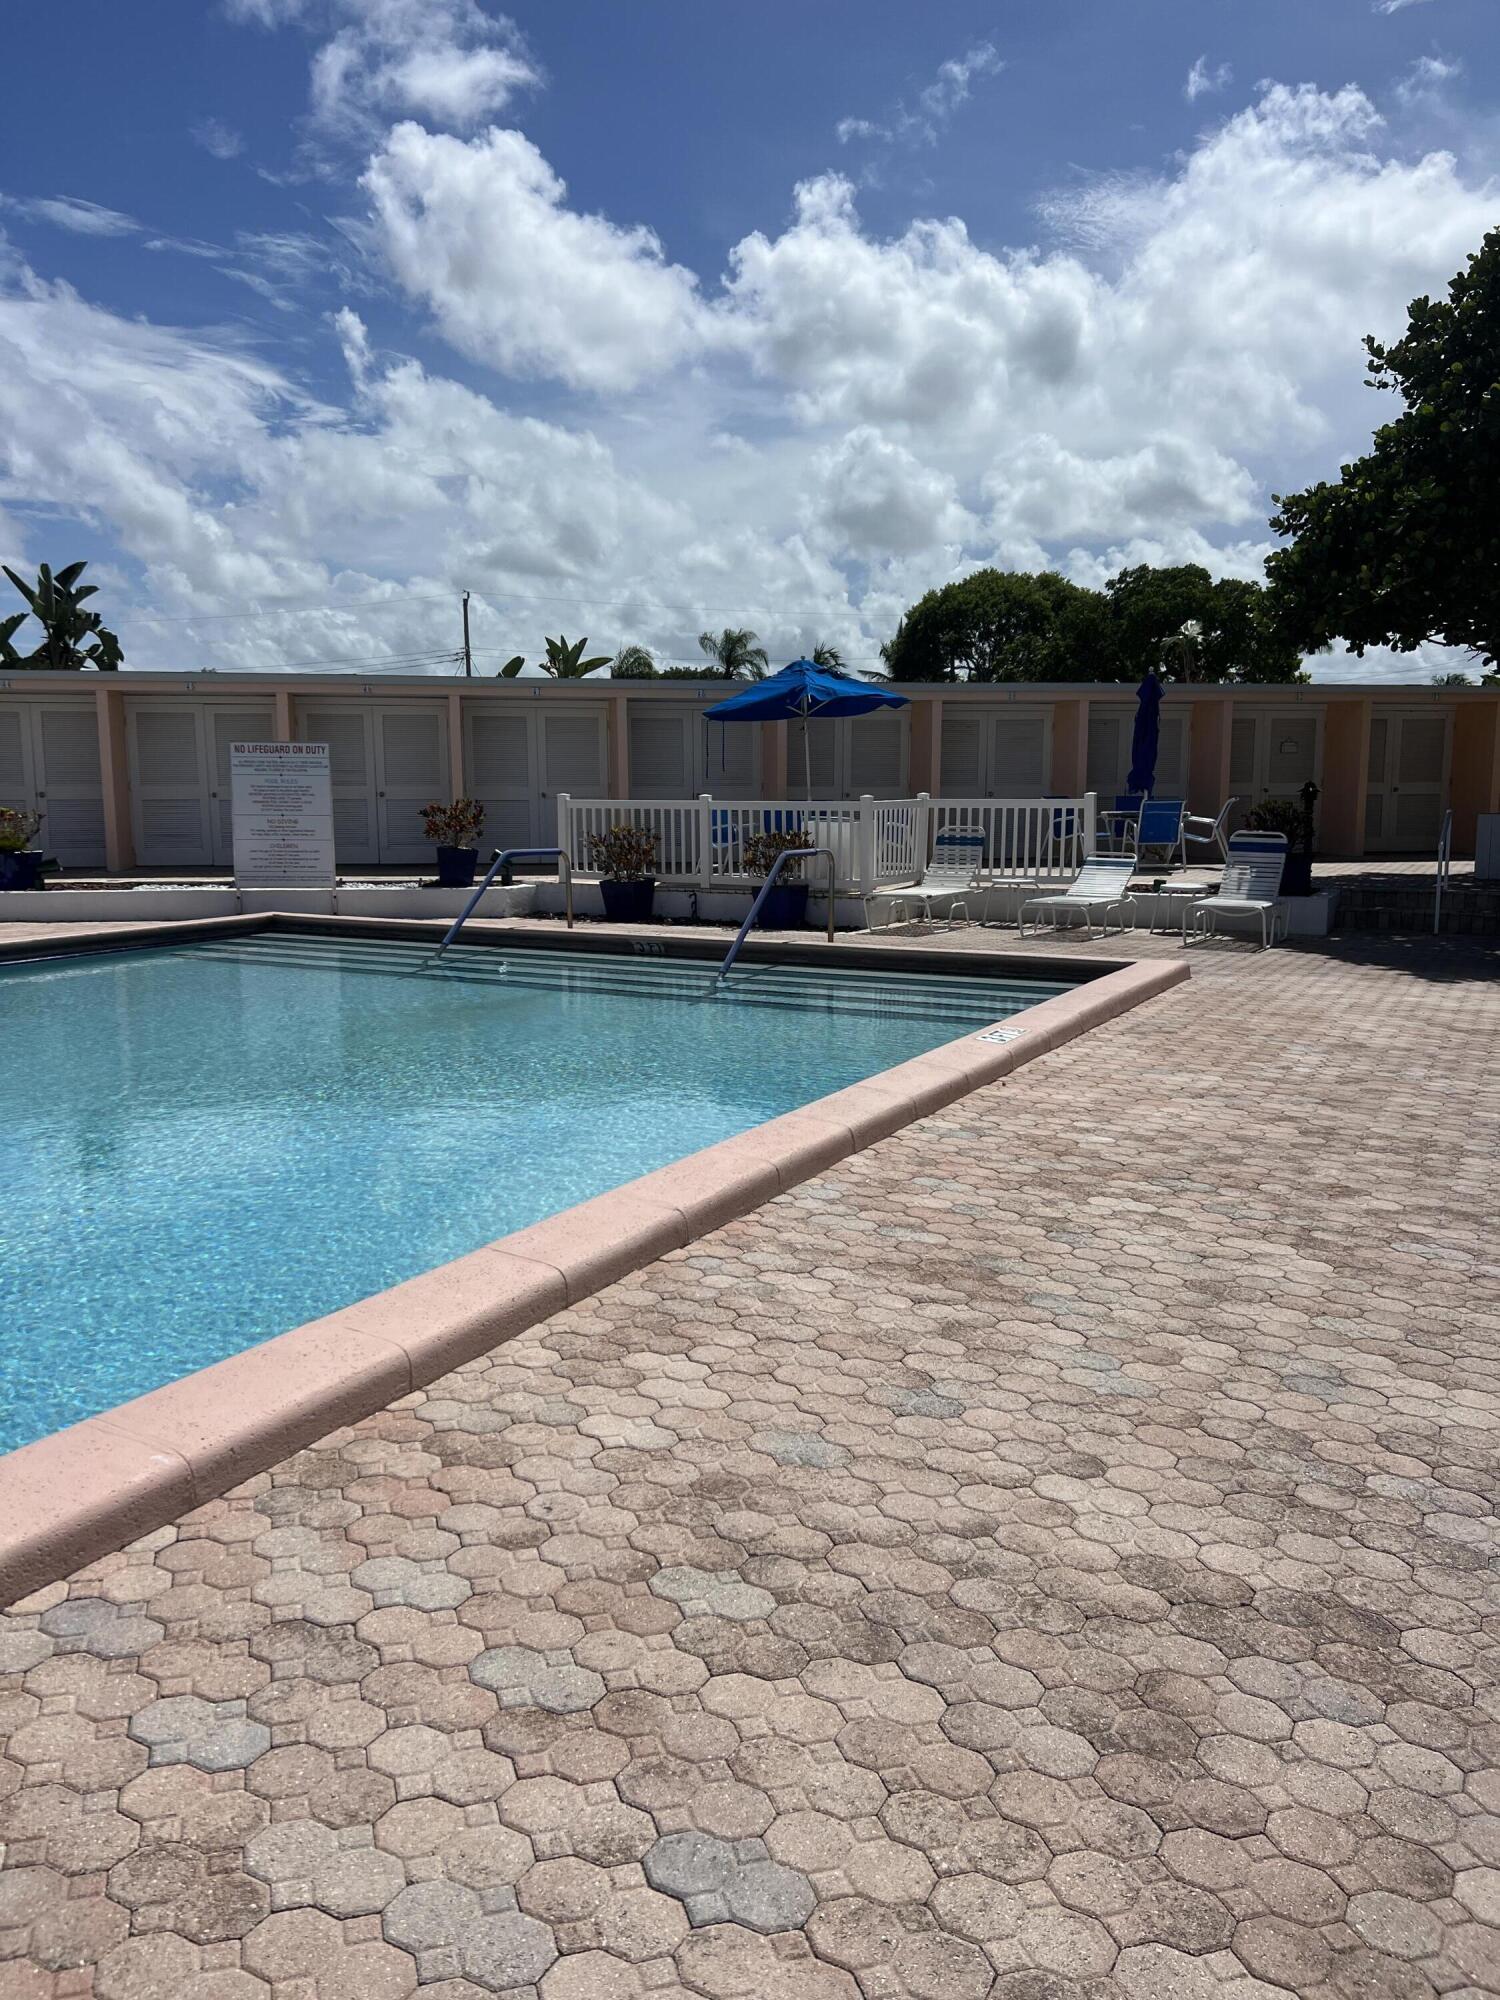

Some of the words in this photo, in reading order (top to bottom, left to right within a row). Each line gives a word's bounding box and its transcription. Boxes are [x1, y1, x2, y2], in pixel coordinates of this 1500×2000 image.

[234, 744, 246, 754] NO
[247, 744, 290, 754] LIFEGUARD
[292, 745, 303, 754] ON
[306, 745, 326, 754] DUTY
